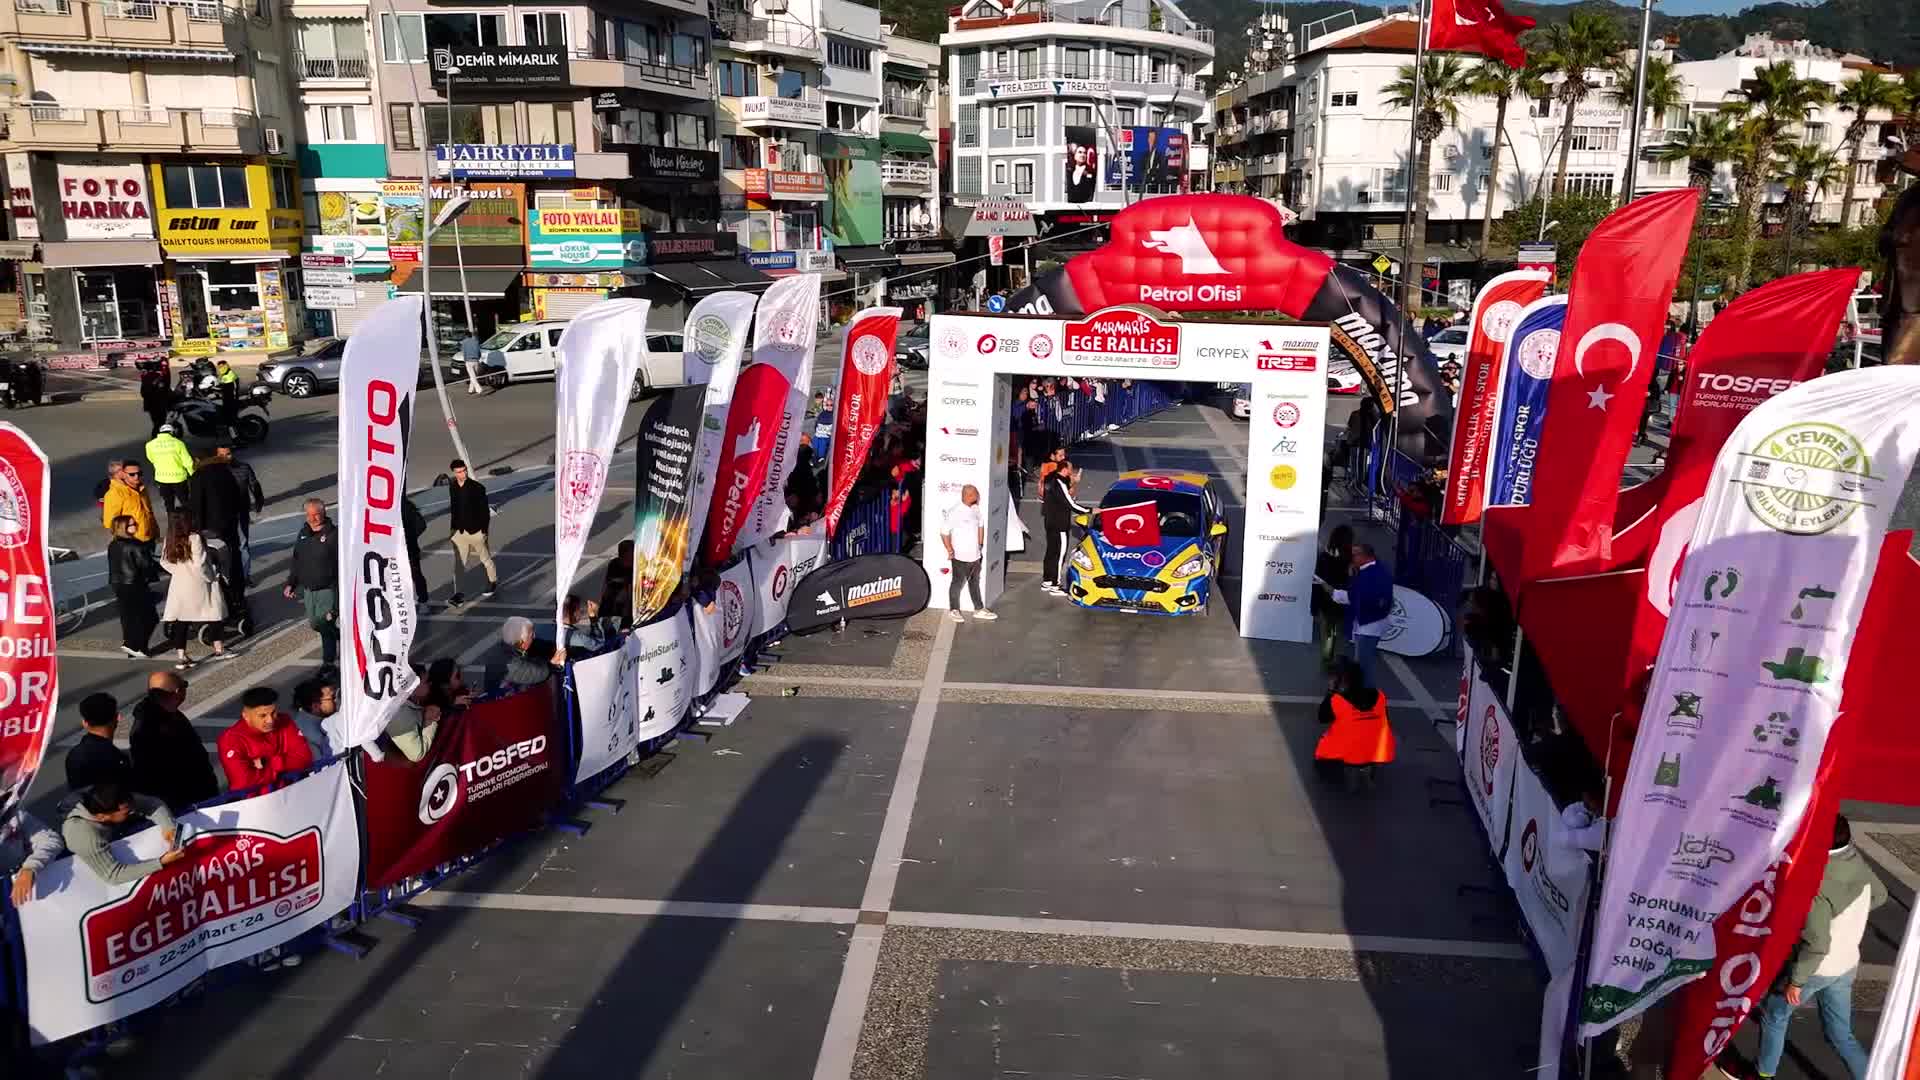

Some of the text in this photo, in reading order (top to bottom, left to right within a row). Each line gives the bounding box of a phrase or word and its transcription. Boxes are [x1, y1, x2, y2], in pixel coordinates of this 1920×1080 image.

[456, 51, 560, 67] DEMİR MİMARLIK
[1002, 84, 1022, 93] TREA
[1066, 82, 1087, 91] TREA
[444, 143, 565, 161] BAHRİYELİ
[63, 178, 141, 197] FOTO
[63, 197, 149, 219] HARİKA
[976, 211, 1030, 221] GRAND BAZAAR
[543, 213, 571, 225] FOTO
[574, 213, 618, 225] YAYLALI
[216, 237, 270, 246] INFORMATION
[1140, 284, 1242, 302] Petrol Ofisi
[999, 338, 1020, 346] TOS
[999, 345, 1020, 353] FED
[1070, 335, 1102, 351] EGE
[1281, 338, 1320, 348] maxima
[1196, 347, 1249, 360] ICRYPEX
[1258, 356, 1295, 369] TRS
[1476, 362, 1490, 392] SPOR
[852, 393, 863, 417] SPOR
[1514, 404, 1531, 433] SPOR
[1786, 430, 1849, 456] ÇEVRE
[363, 379, 397, 545] TOTO
[1102, 551, 1142, 562] Hypco
[846, 575, 902, 601] maxima
[458, 734, 547, 783] TOSFED
[1626, 914, 1681, 939] YAŞAM
[106, 910, 174, 965] EGE
[159, 938, 197, 967] 22-24
[198, 921, 237, 943] Mart
